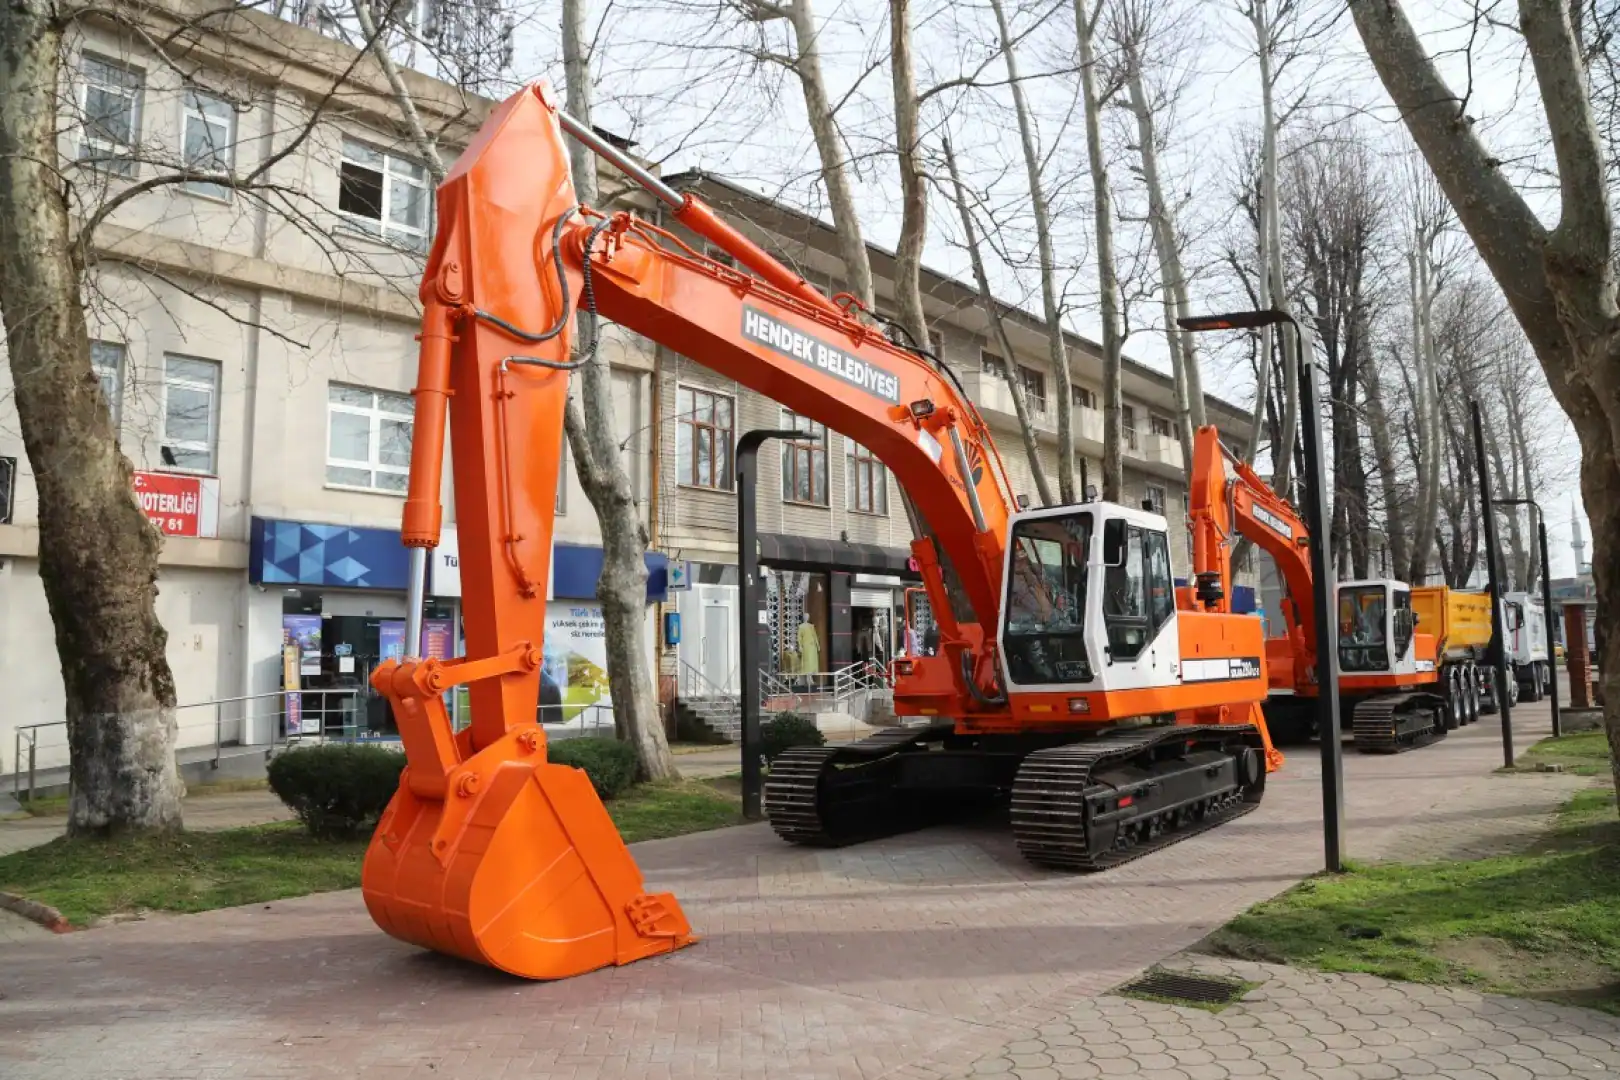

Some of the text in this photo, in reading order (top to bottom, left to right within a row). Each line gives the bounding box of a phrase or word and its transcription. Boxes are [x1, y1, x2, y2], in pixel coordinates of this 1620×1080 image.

[746, 311, 898, 401] HENDEK BELEDİYESİ
[168, 518, 183, 530] 61
